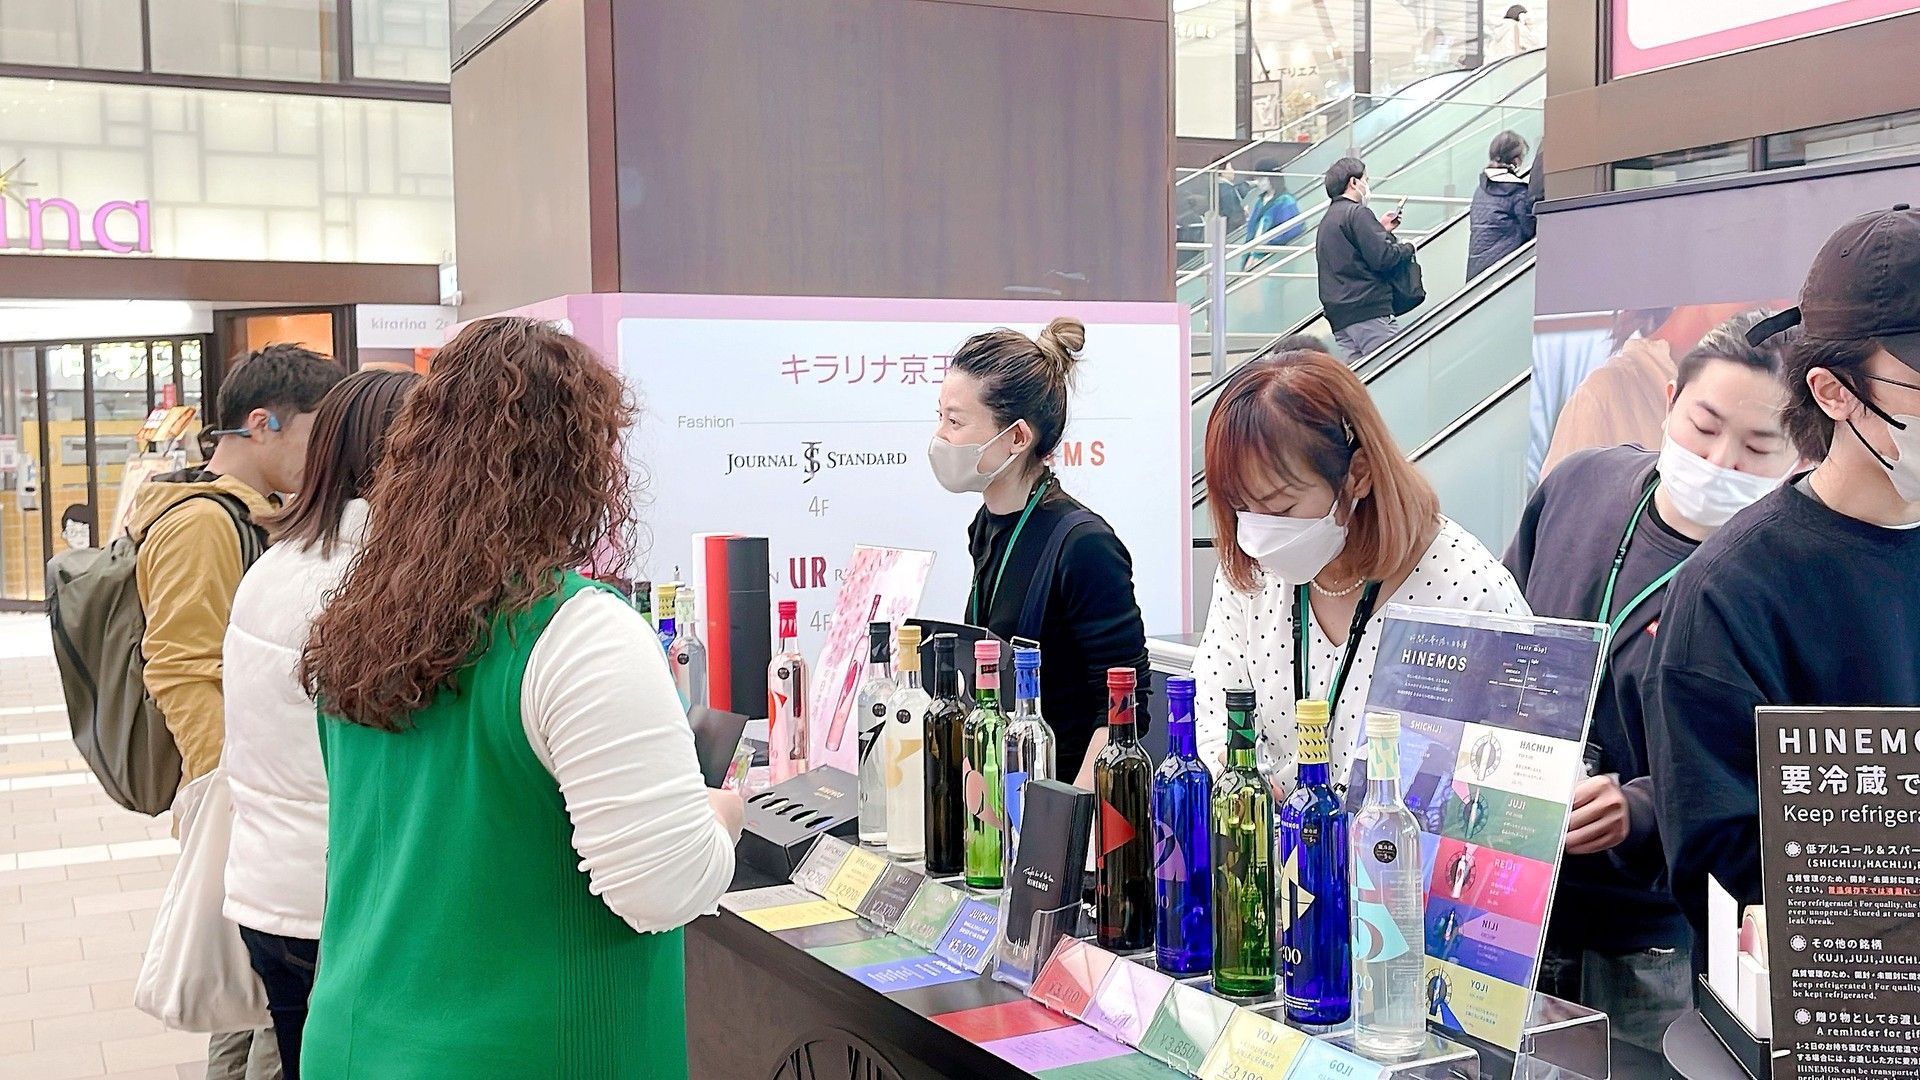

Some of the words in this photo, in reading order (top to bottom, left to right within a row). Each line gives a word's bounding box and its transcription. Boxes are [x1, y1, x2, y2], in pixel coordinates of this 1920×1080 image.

[371, 317, 427, 330] kirarina
[677, 414, 735, 429] Fashion
[1050, 440, 1106, 467] MS
[808, 495, 830, 517] 4F
[789, 556, 827, 589] UR
[810, 610, 832, 632] 4F
[1401, 648, 1467, 672] HINEMOS
[1519, 740, 1554, 755] HACHIJI
[1507, 798, 1527, 811] JUJI
[1783, 804, 1835, 827] Keep
[1841, 805, 1920, 828] refriger
[1788, 898, 1806, 908] Keep
[1808, 898, 1853, 909] refrigerated
[1905, 900, 1917, 909] the
[1853, 909, 1880, 918] Stored
[1882, 910, 1891, 918] at
[1481, 919, 1500, 932] NIJI
[1788, 917, 1835, 926] leak/break.
[1811, 938, 1883, 951] その他の銘柄
[1812, 952, 1920, 965] (KUJI,JUJI,JUICHI
[1470, 979, 1489, 994] YOJI
[1792, 980, 1813, 990] Keep
[1815, 981, 1866, 991] refrigerated
[1874, 983, 1890, 991] For
[1792, 989, 1802, 997] be
[1804, 990, 1822, 999] kept
[1824, 990, 1877, 1000] refrigerated.
[1257, 1028, 1278, 1045] YOJI
[1816, 1026, 1824, 1036] A
[1827, 1027, 1880, 1038] reminder
[1883, 1028, 1901, 1038] for
[1329, 1059, 1354, 1077] GOJI
[1797, 1065, 1840, 1073] HINEMOS
[1858, 1067, 1868, 1075] be
[1870, 1067, 1919, 1077] transported
